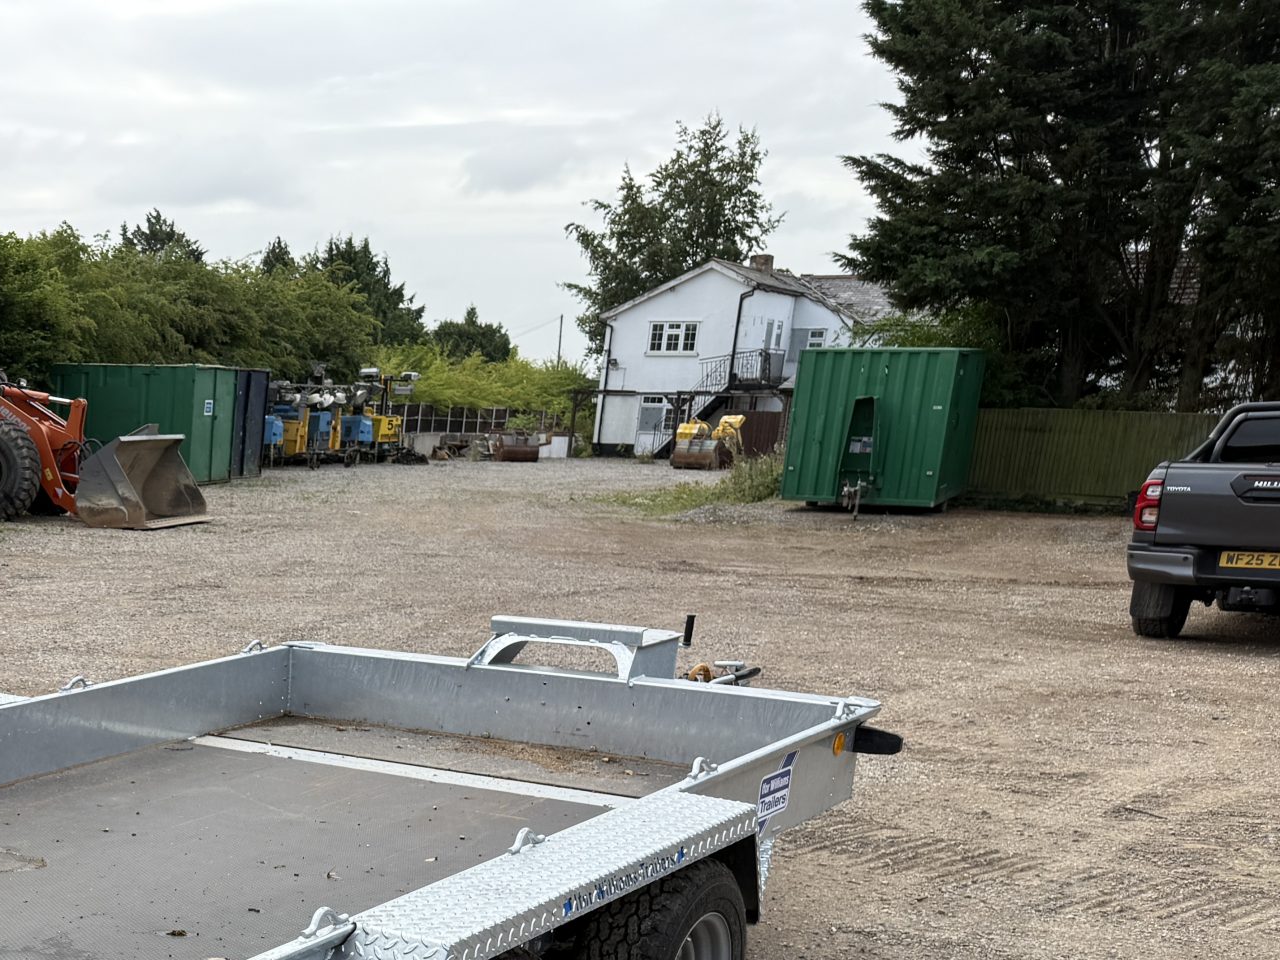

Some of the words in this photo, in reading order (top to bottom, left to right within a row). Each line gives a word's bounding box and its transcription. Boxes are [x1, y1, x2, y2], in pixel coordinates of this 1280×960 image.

[387, 419, 394, 431] 5
[1225, 553, 1265, 566] WF25
[1267, 554, 1280, 567] Z
[760, 794, 787, 813] Trailers
[639, 855, 677, 881] Trailers
